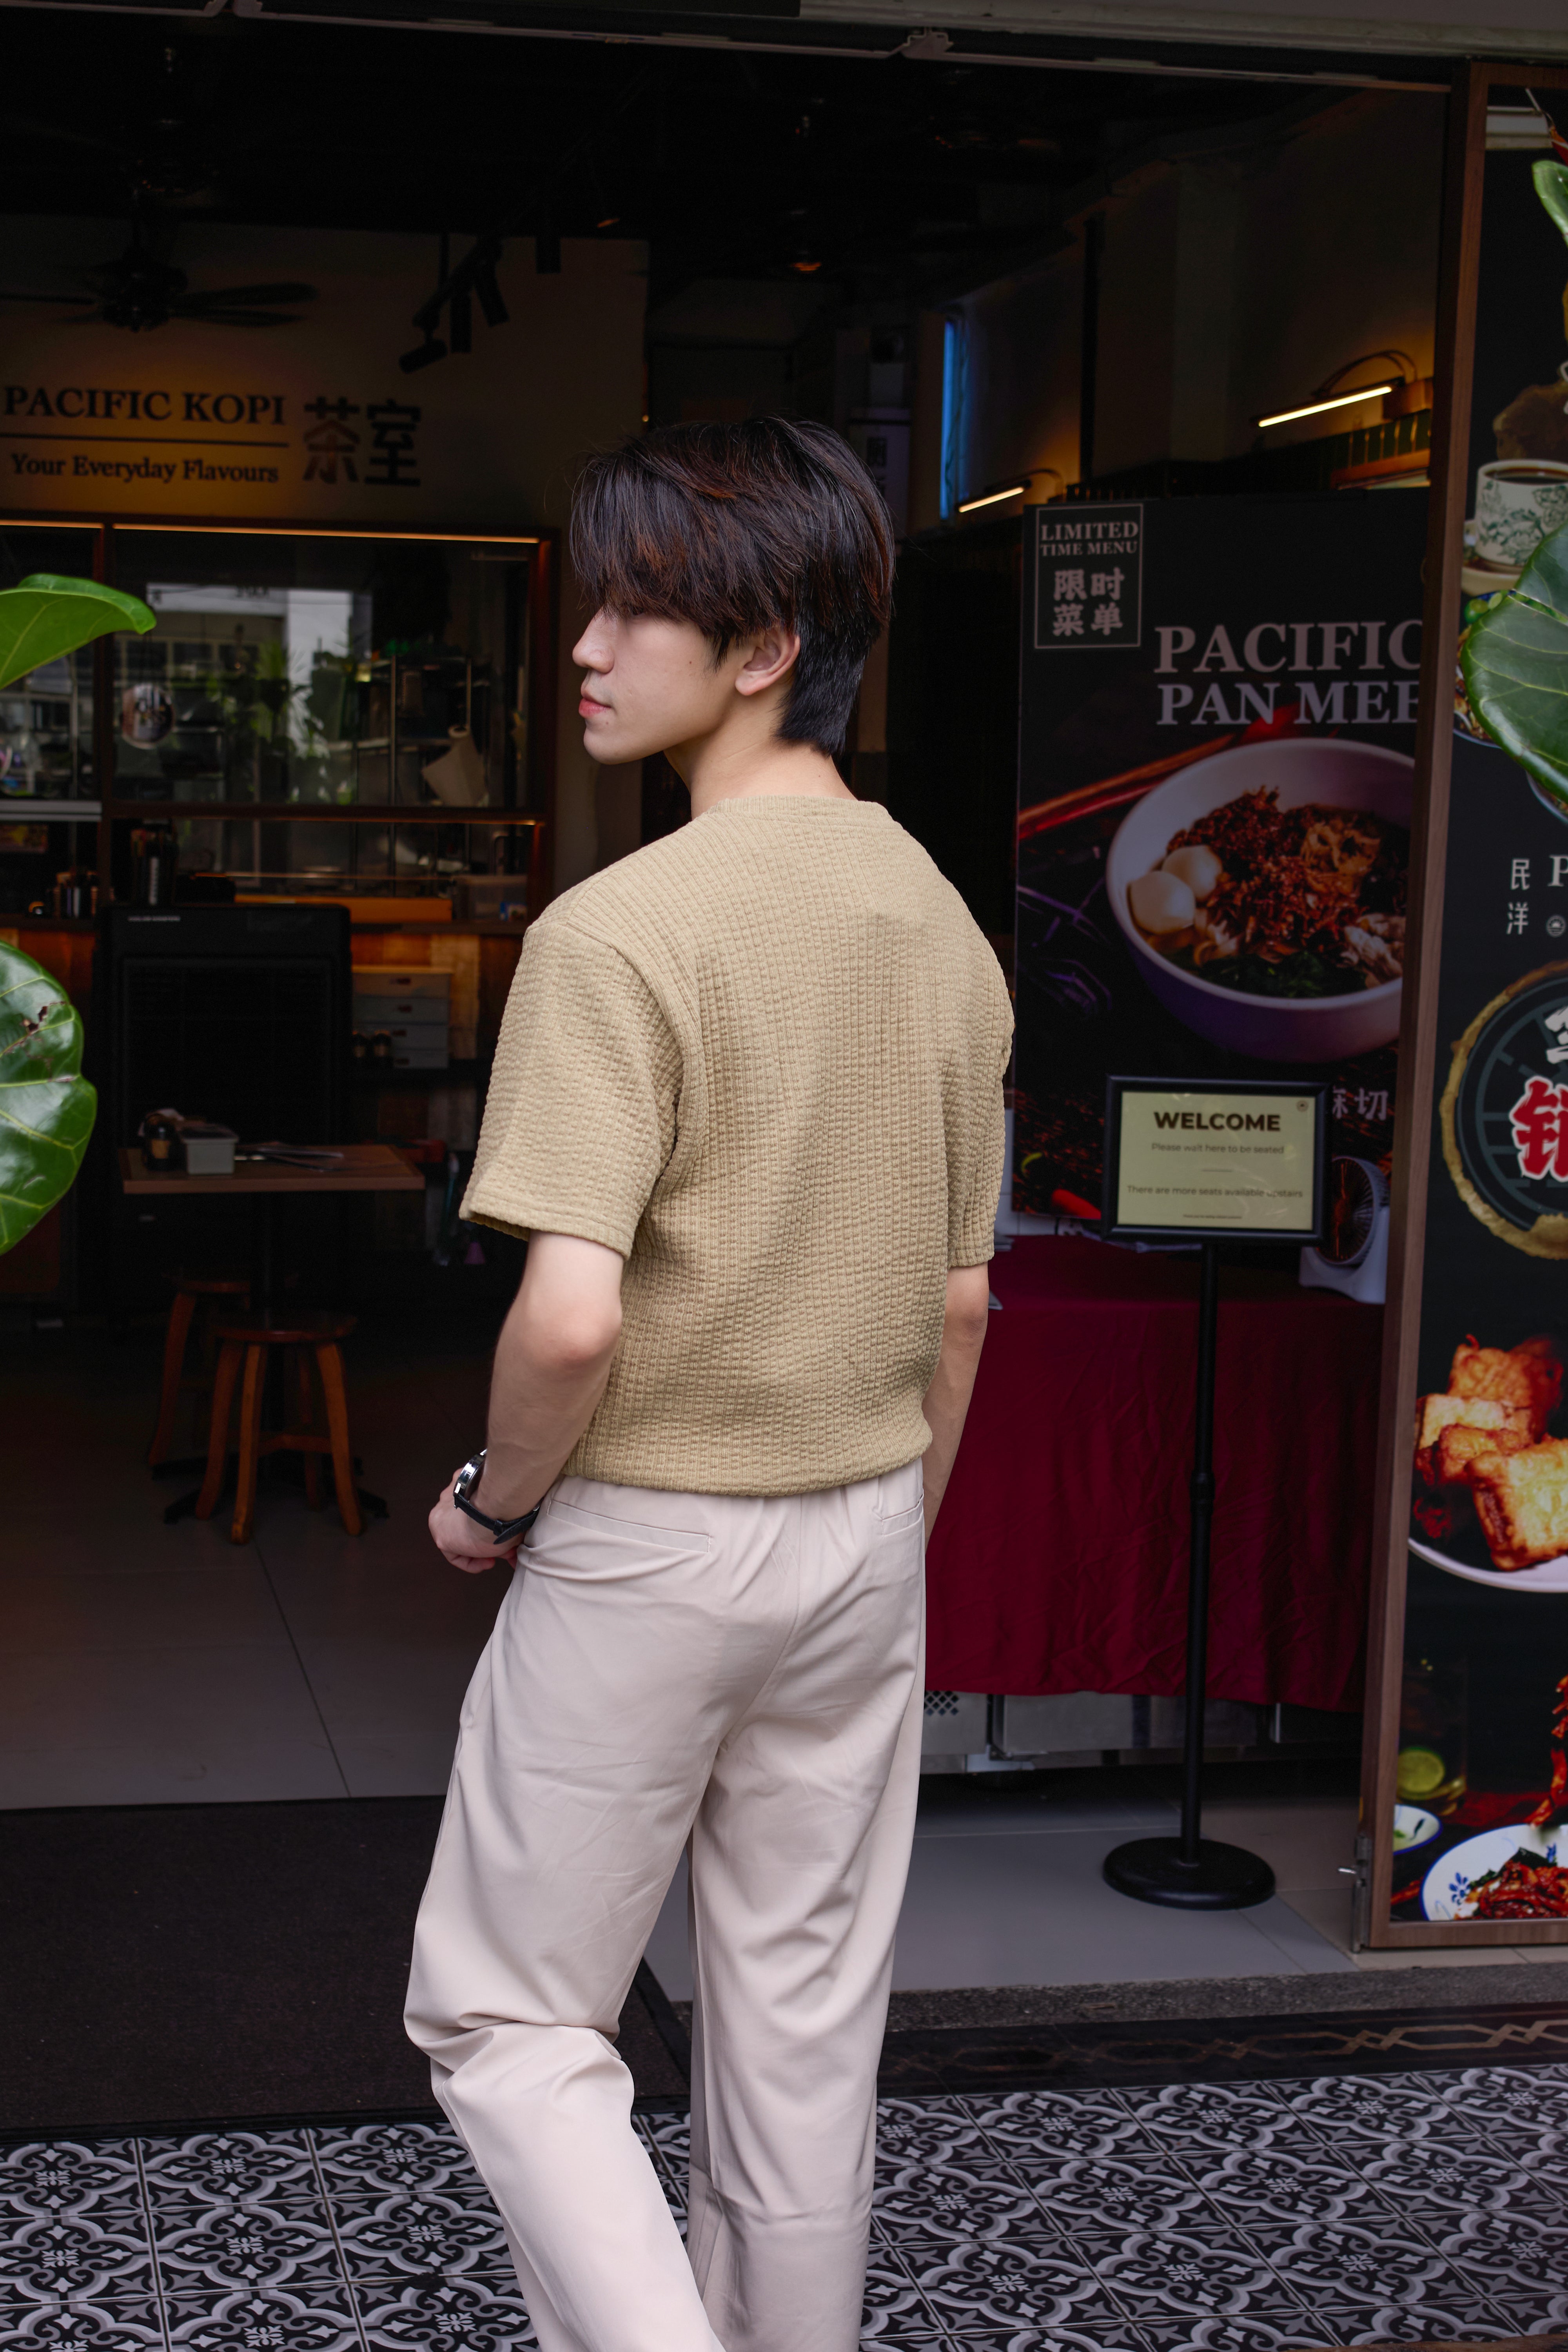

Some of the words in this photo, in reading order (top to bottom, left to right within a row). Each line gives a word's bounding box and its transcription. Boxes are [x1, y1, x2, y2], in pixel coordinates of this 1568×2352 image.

[4, 386, 172, 421] PACIFIC
[181, 392, 286, 426] KOPI
[303, 396, 421, 487] 茶室
[11, 453, 65, 475] Your
[73, 456, 174, 483] Everyday
[183, 459, 279, 482] Flavours
[1041, 521, 1139, 541] LIMITED
[1040, 543, 1083, 557] TIME
[1087, 540, 1138, 555] MENU
[1053, 567, 1125, 601] 限时
[1052, 602, 1123, 637] 菜单
[1153, 619, 1423, 673] PACIFIC
[1156, 682, 1281, 725] PAN
[1154, 1112, 1281, 1132] WELCOME
[1151, 1143, 1181, 1152] Please
[1183, 1144, 1203, 1152] wait
[1205, 1144, 1226, 1153] here
[1240, 1145, 1251, 1153] be
[1254, 1145, 1284, 1154] seated
[1127, 1185, 1152, 1194] There
[1199, 1187, 1222, 1196] seats
[1225, 1188, 1265, 1197] available
